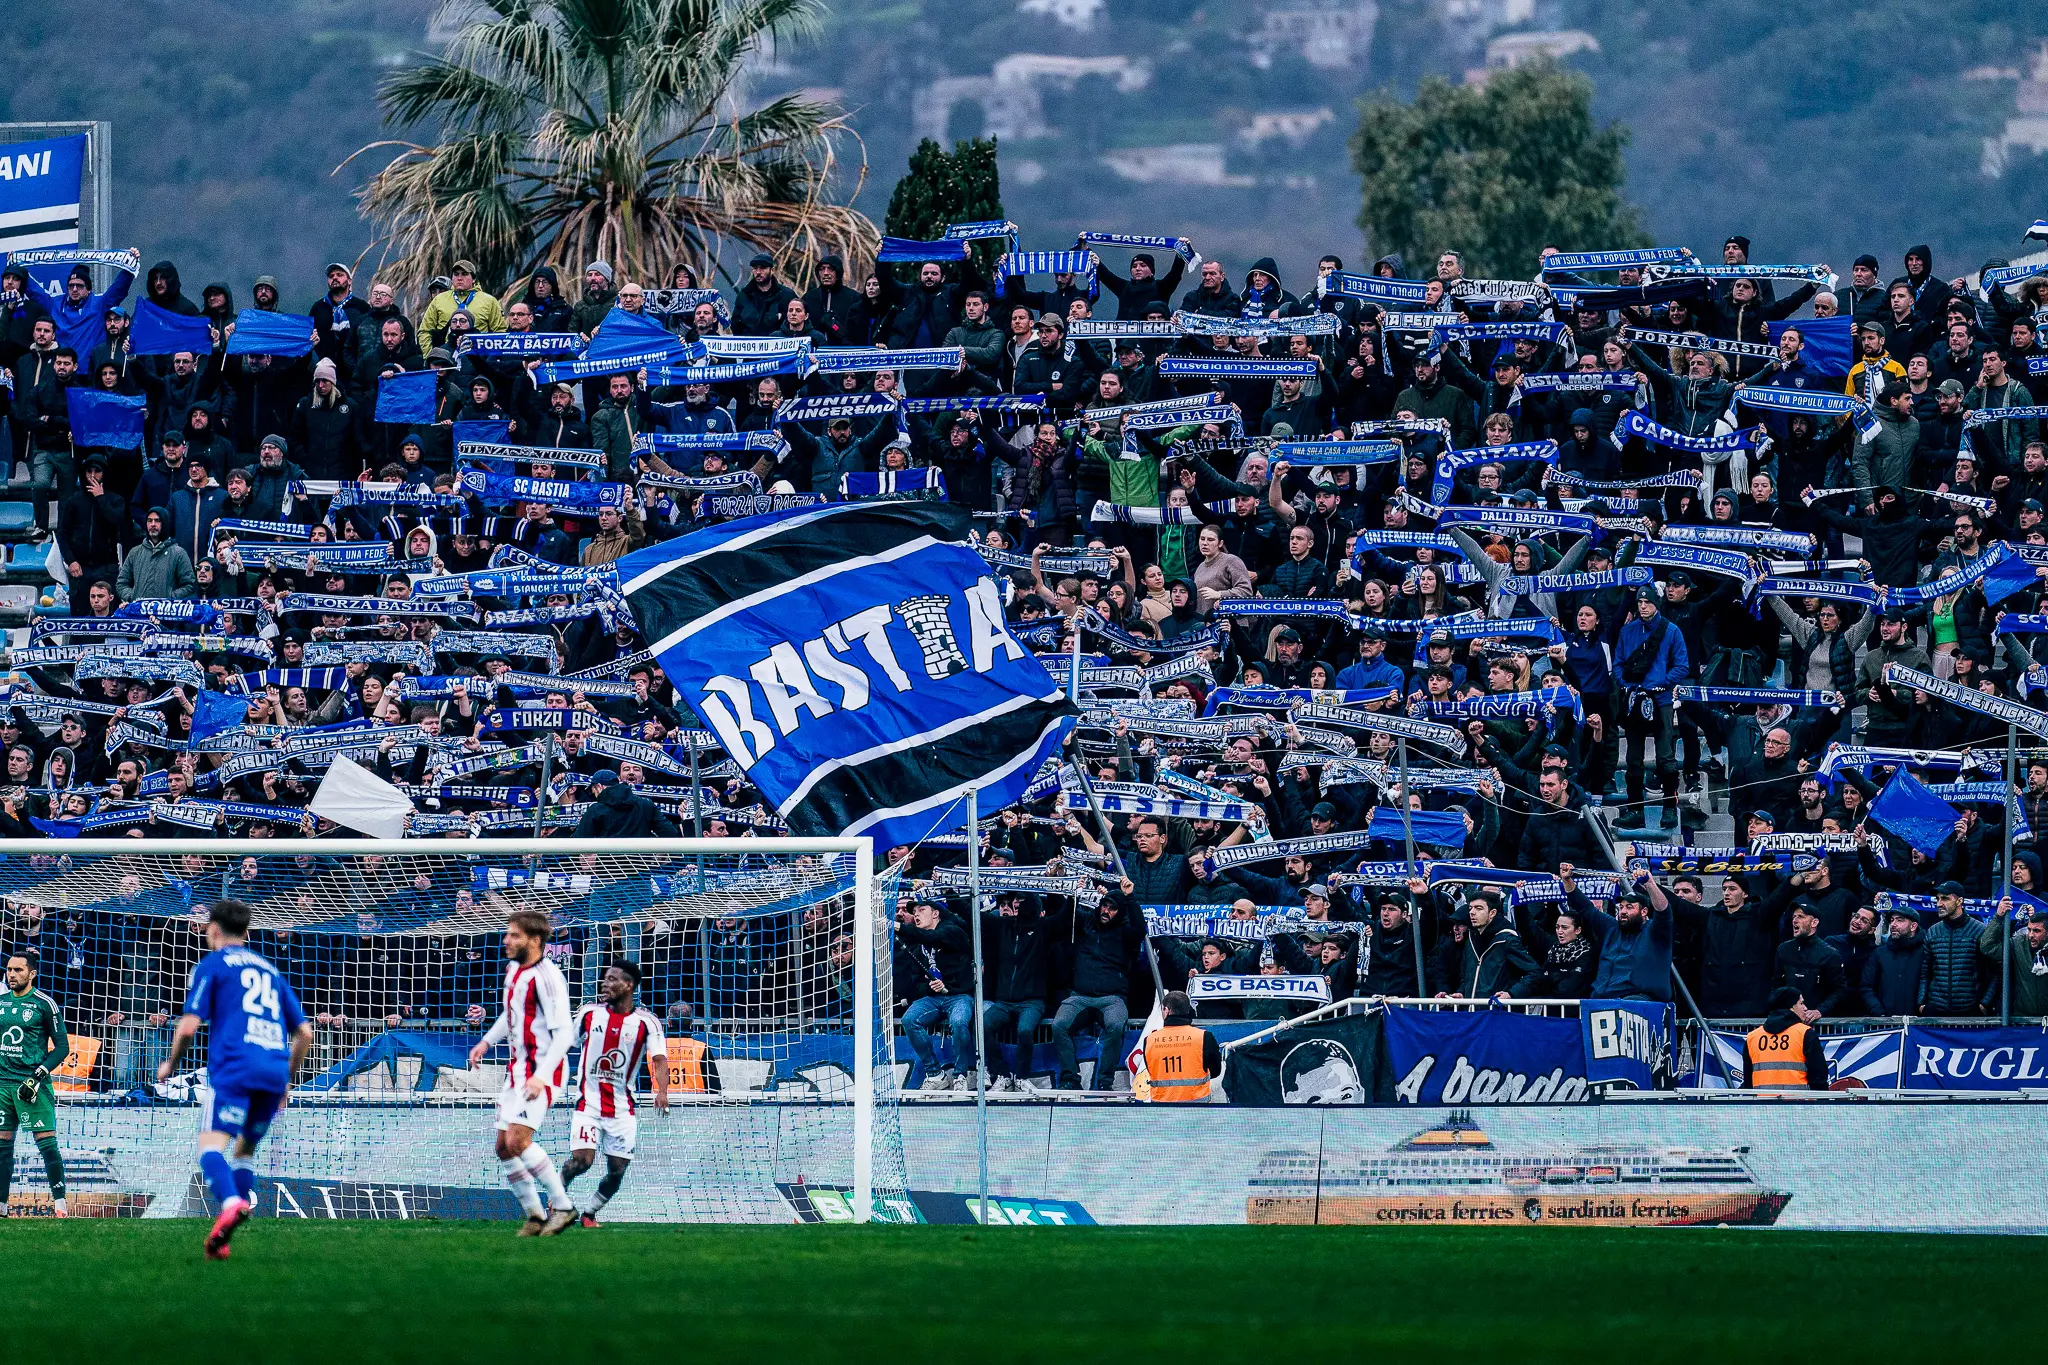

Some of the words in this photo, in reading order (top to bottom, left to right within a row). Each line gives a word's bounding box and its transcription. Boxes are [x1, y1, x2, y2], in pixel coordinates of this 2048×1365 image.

[1112, 234, 1166, 245] BASTIA
[1591, 254, 1600, 263] UN
[1604, 251, 1637, 262] POPULU,
[1640, 250, 1655, 259] UNA
[1657, 249, 1678, 259] FEDE
[1448, 326, 1481, 340] S.C.
[1486, 323, 1550, 338] BASTIA
[477, 339, 521, 350] FORZA
[524, 337, 572, 349] BASTIA
[1635, 331, 1691, 346] FORZA
[1719, 341, 1778, 356] BASTIA
[573, 362, 589, 373] UN
[591, 359, 619, 372] FEMU
[644, 351, 667, 364] UNU
[1172, 362, 1209, 370] BASTIA
[1253, 364, 1304, 372] SPORTING
[687, 368, 702, 380] UN
[704, 366, 733, 379] FEMU
[1525, 375, 1565, 386] TESTA
[1568, 373, 1613, 385] MORA
[807, 395, 870, 406] UNITI
[906, 397, 1021, 411] BASTIA
[1779, 392, 1790, 402] UN
[1792, 394, 1825, 408] POPULU,
[1828, 399, 1843, 408] UNA
[1181, 409, 1236, 422] BASTIA
[662, 434, 694, 442] TESTA
[1631, 416, 1740, 448] CAPITANU
[1438, 444, 1557, 477] CAPITANU
[698, 471, 756, 484] BASTIA
[363, 490, 395, 501] FORZA
[398, 491, 437, 501] BASTIA
[514, 480, 527, 491] SC
[532, 481, 569, 497] BASTIA
[712, 497, 753, 515] FORZA
[1481, 511, 1513, 522] DALLI
[1516, 513, 1554, 524] BASTIA
[260, 521, 306, 534] BASTIA
[1366, 533, 1382, 544] UN
[1383, 532, 1408, 544] FEMU
[345, 550, 361, 559] UNA
[364, 548, 384, 558] FEDE
[1537, 573, 1573, 586] FORZA
[1575, 569, 1613, 585] BASTIA
[1777, 580, 1809, 591] DALLI
[1809, 583, 1847, 594] BASTIA
[1920, 586, 1935, 597] UN
[1938, 576, 1966, 593] FEMU
[140, 601, 155, 616] SC
[157, 602, 193, 616] BASTIA
[314, 597, 373, 610] FORZA
[378, 601, 441, 612] BASTIA
[1219, 603, 1271, 611] SPORTING
[1273, 603, 1302, 611] CLUB
[1304, 603, 1315, 611] DI
[616, 611, 637, 629] CLUB
[1511, 620, 1535, 631] UNU
[1161, 627, 1212, 648] BASTIA
[11, 646, 80, 663] TRIBUNA
[1892, 666, 1959, 698] TRIBUNA
[1754, 690, 1800, 698] TURCHINU
[513, 711, 562, 728] FORZA
[572, 711, 622, 735] BASTIA
[590, 736, 657, 766] TRIBUNA
[1841, 755, 1873, 765] BASTIA
[451, 786, 509, 799] BASTIA
[1133, 785, 1157, 799] VOUS
[225, 804, 251, 812] CLUB
[105, 811, 131, 822] CLUB
[1213, 843, 1279, 867] TRIBUNA
[1659, 860, 1700, 872] S.C.
[1704, 860, 1784, 872] Bastia
[1517, 880, 1561, 898] FORZA
[1202, 980, 1235, 991] SC
[1240, 979, 1319, 993] BASTIA
[240, 967, 281, 1021] 24
[1154, 1034, 1192, 1043] HESTIA
[1591, 1010, 1650, 1064] BASTIA
[1758, 1034, 1790, 1051] 038
[1162, 1055, 1182, 1073] 111
[1396, 1055, 1435, 1103] A
[1442, 1055, 1591, 1103] banda
[1376, 1202, 1446, 1220] corsica
[1452, 1200, 1514, 1220] ferries
[1547, 1199, 1625, 1220] sardinia
[1631, 1198, 1689, 1219] ferries
